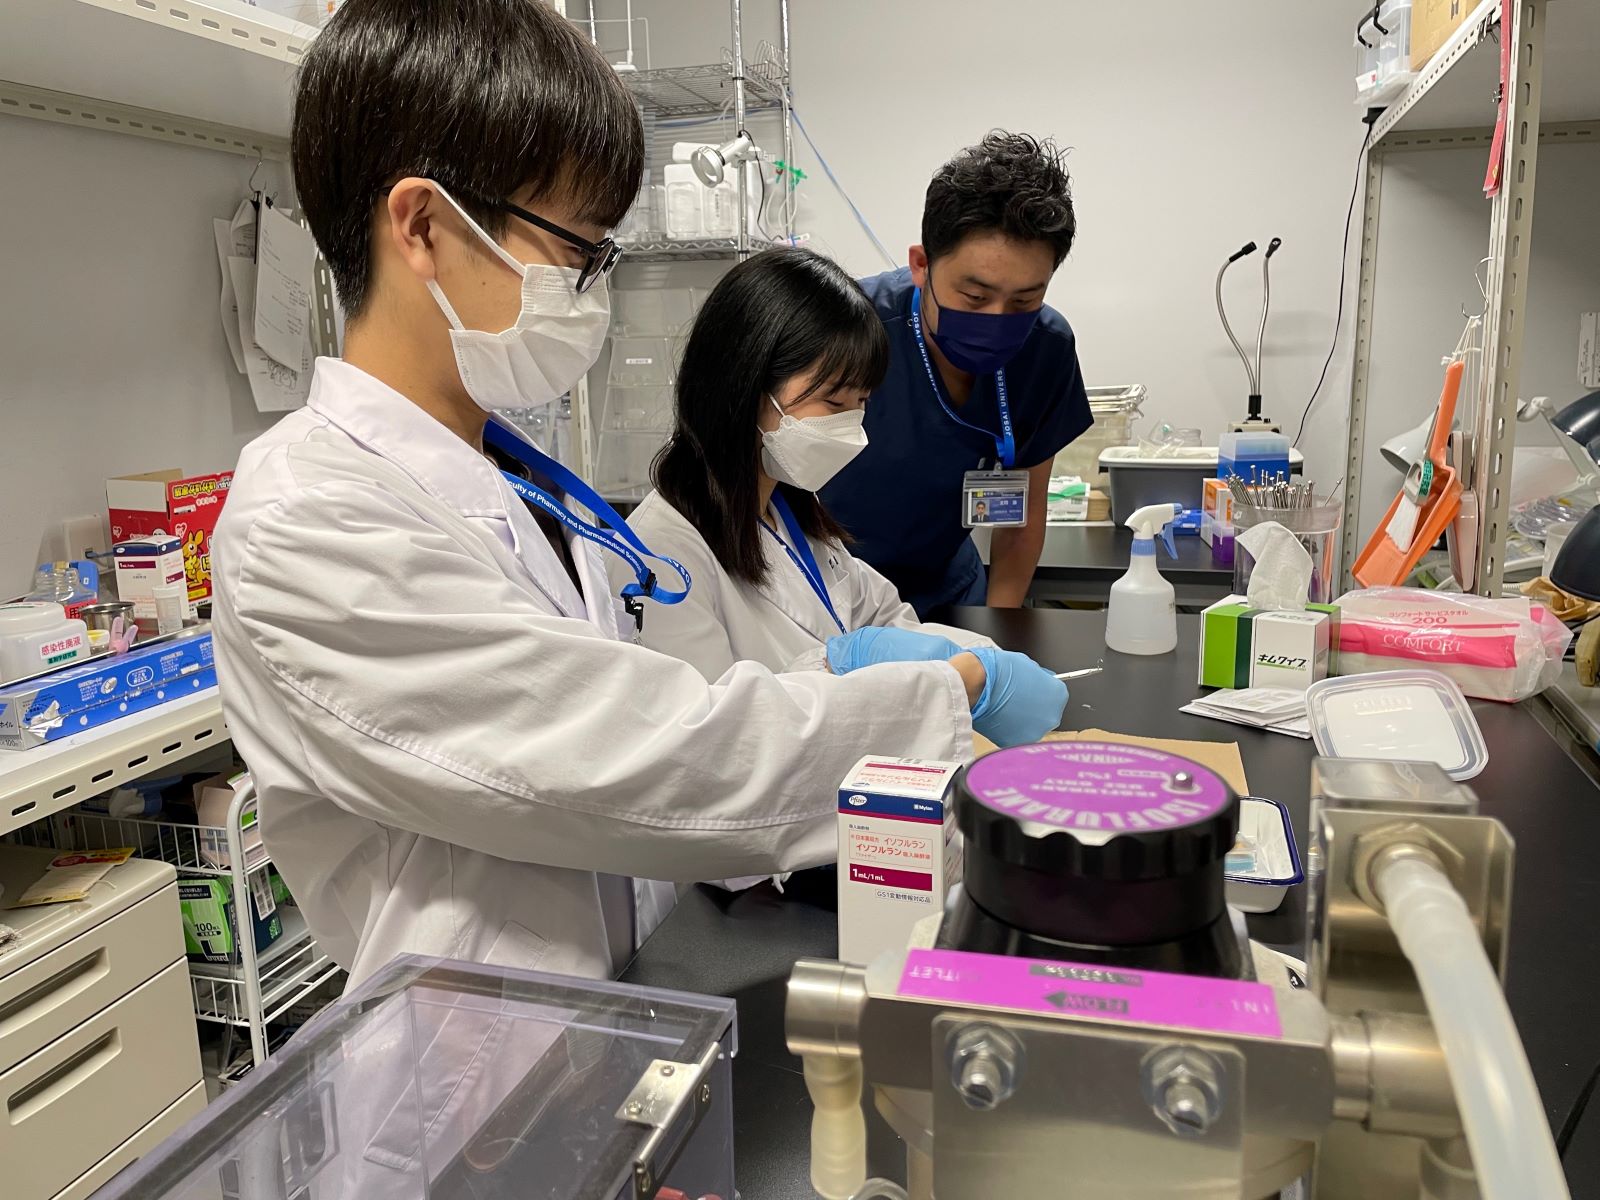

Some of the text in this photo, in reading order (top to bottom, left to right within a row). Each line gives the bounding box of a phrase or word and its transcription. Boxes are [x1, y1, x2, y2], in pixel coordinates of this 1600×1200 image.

[911, 311, 921, 339] JOSAI
[995, 368, 1012, 437] JOSAI UNIVERS
[527, 490, 537, 499] of
[536, 493, 567, 521] Pharmacy
[566, 517, 578, 529] and
[578, 524, 626, 556] Pharmaceutical
[1412, 616, 1447, 624] 200
[1383, 633, 1464, 653] COMFORT
[982, 787, 1211, 828] ISOFLURANE
[856, 843, 902, 856] イソフルラン
[883, 837, 926, 850] イソフルラン
[852, 868, 886, 882] 1mL/1mL
